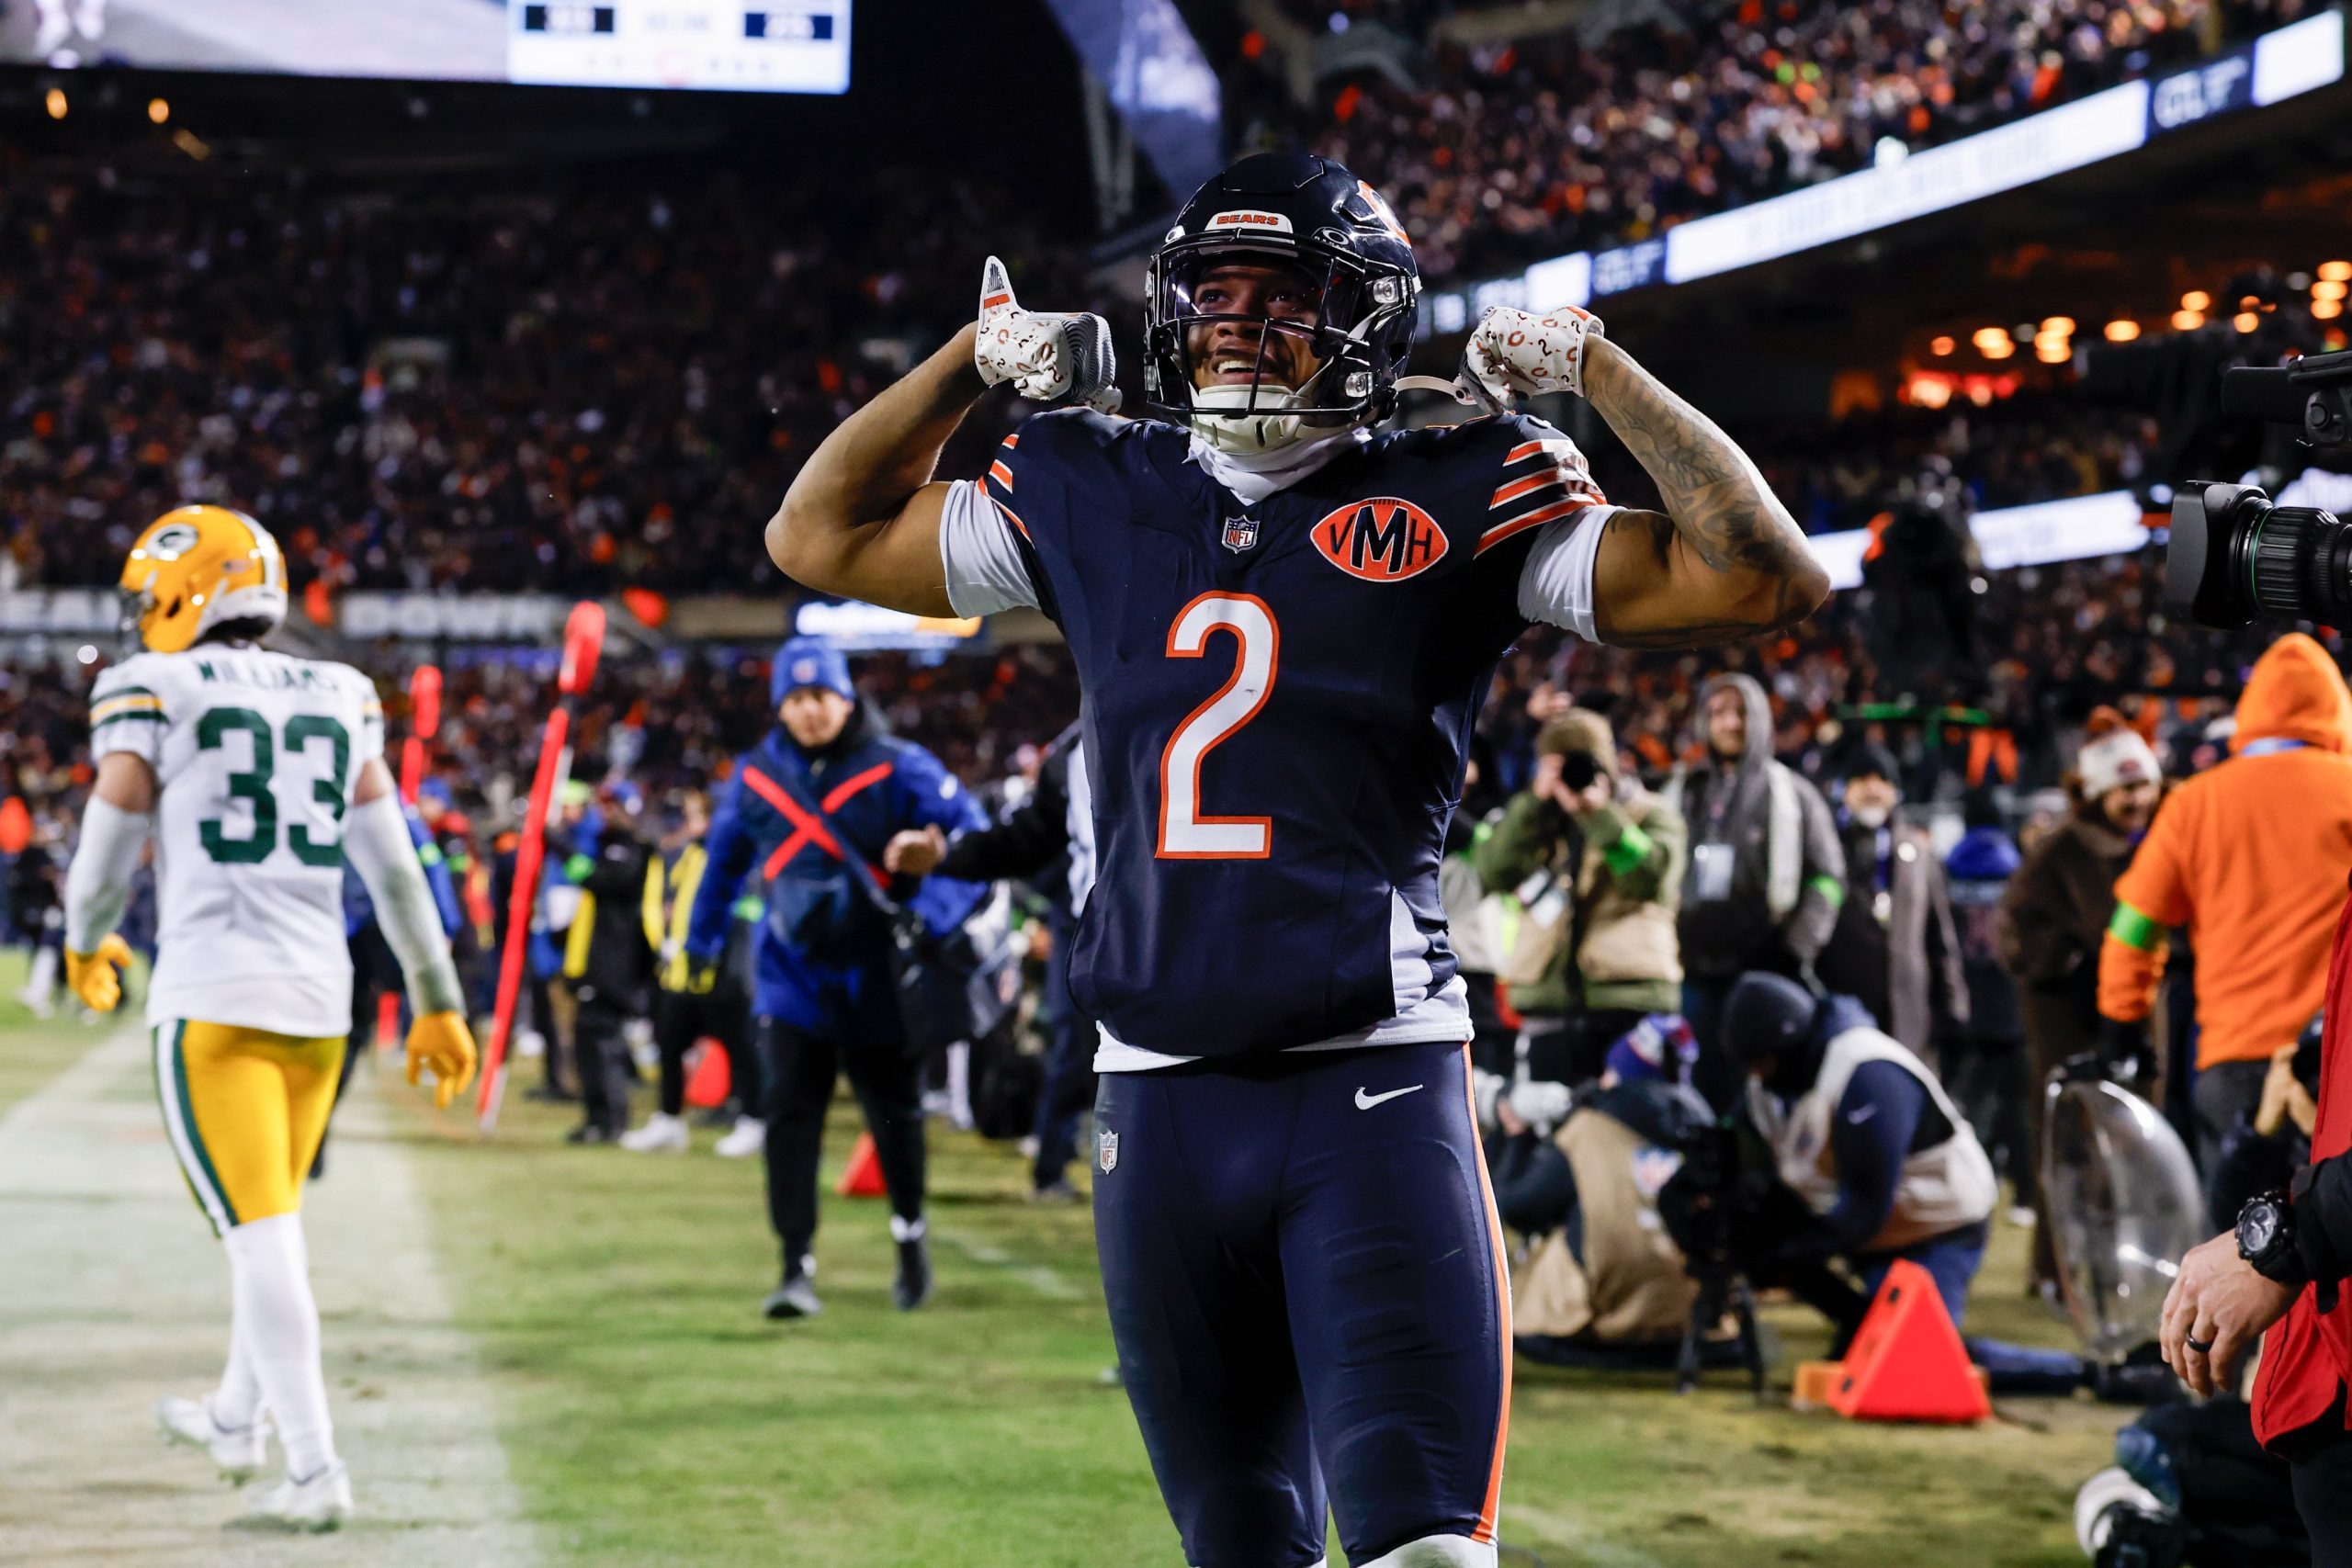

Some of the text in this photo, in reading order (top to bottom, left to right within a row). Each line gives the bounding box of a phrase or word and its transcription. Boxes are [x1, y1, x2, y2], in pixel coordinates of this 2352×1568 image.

[1216, 214, 1279, 226] BEARS
[1538, 339, 1553, 356] 2
[1227, 529, 1251, 547] NFL
[1329, 504, 1432, 574] VMH
[1154, 590, 1281, 860] 2
[196, 707, 350, 867] 33
